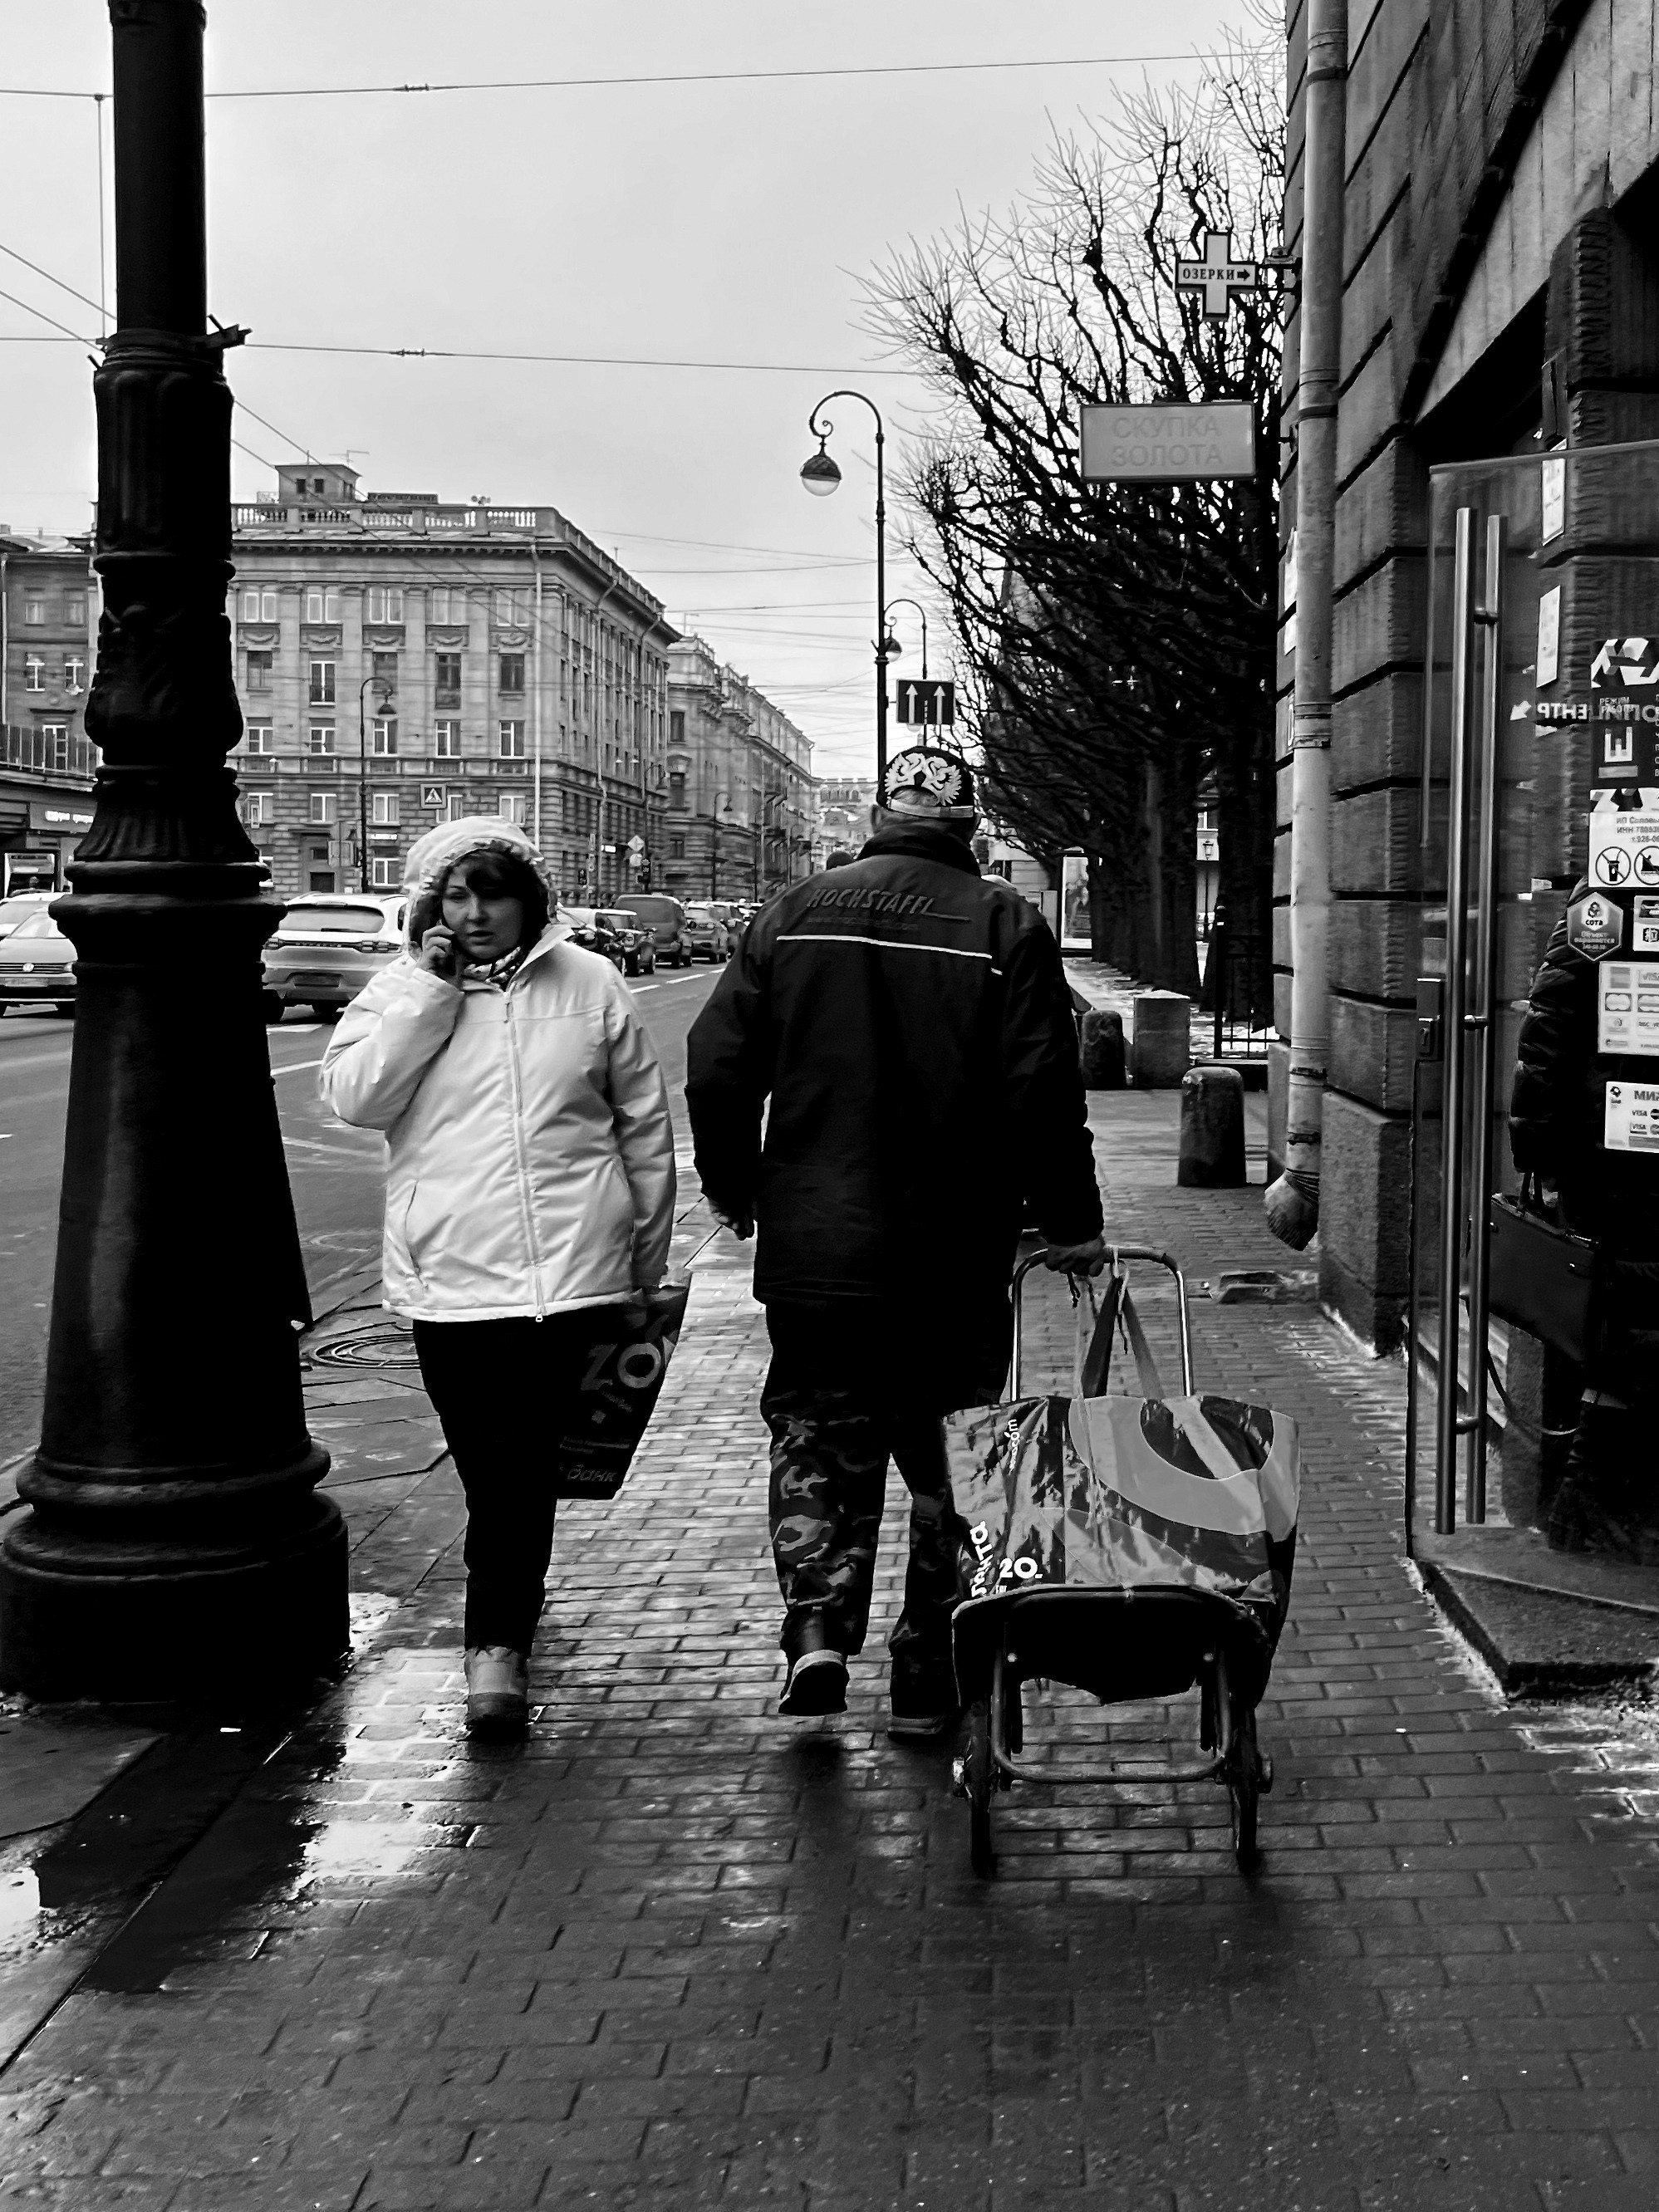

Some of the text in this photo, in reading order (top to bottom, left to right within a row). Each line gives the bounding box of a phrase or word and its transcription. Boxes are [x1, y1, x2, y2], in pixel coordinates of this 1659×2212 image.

[1182, 267, 1235, 281] ОЗЕРКИ
[1113, 416, 1222, 438] СКУПКА
[1112, 444, 1223, 466] ЗОЛОТА
